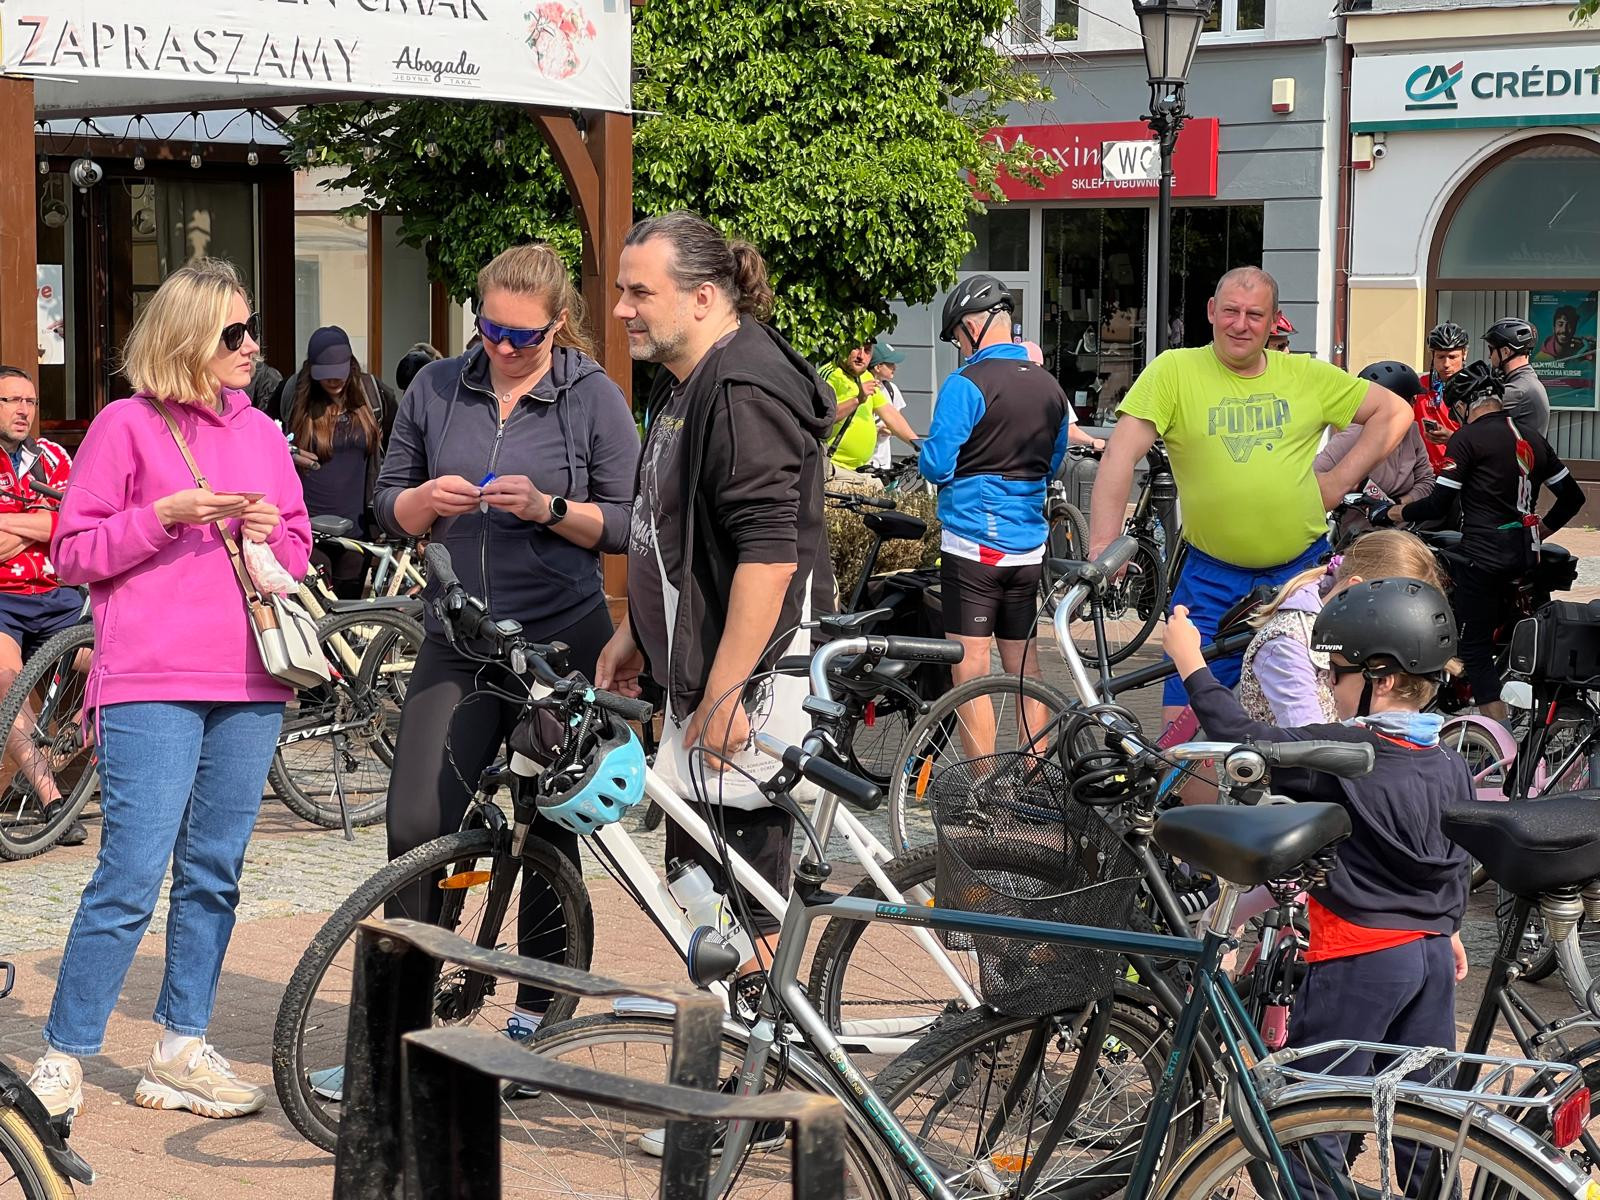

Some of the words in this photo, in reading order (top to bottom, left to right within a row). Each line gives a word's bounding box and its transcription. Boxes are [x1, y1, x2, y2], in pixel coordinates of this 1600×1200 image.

[18, 16, 360, 83] ZAPRASZAMY
[392, 46, 480, 82] Abogada
[1471, 65, 1600, 99] CRÉDIT
[276, 723, 346, 747] LEVEL
[819, 957, 834, 1021] SMAR
